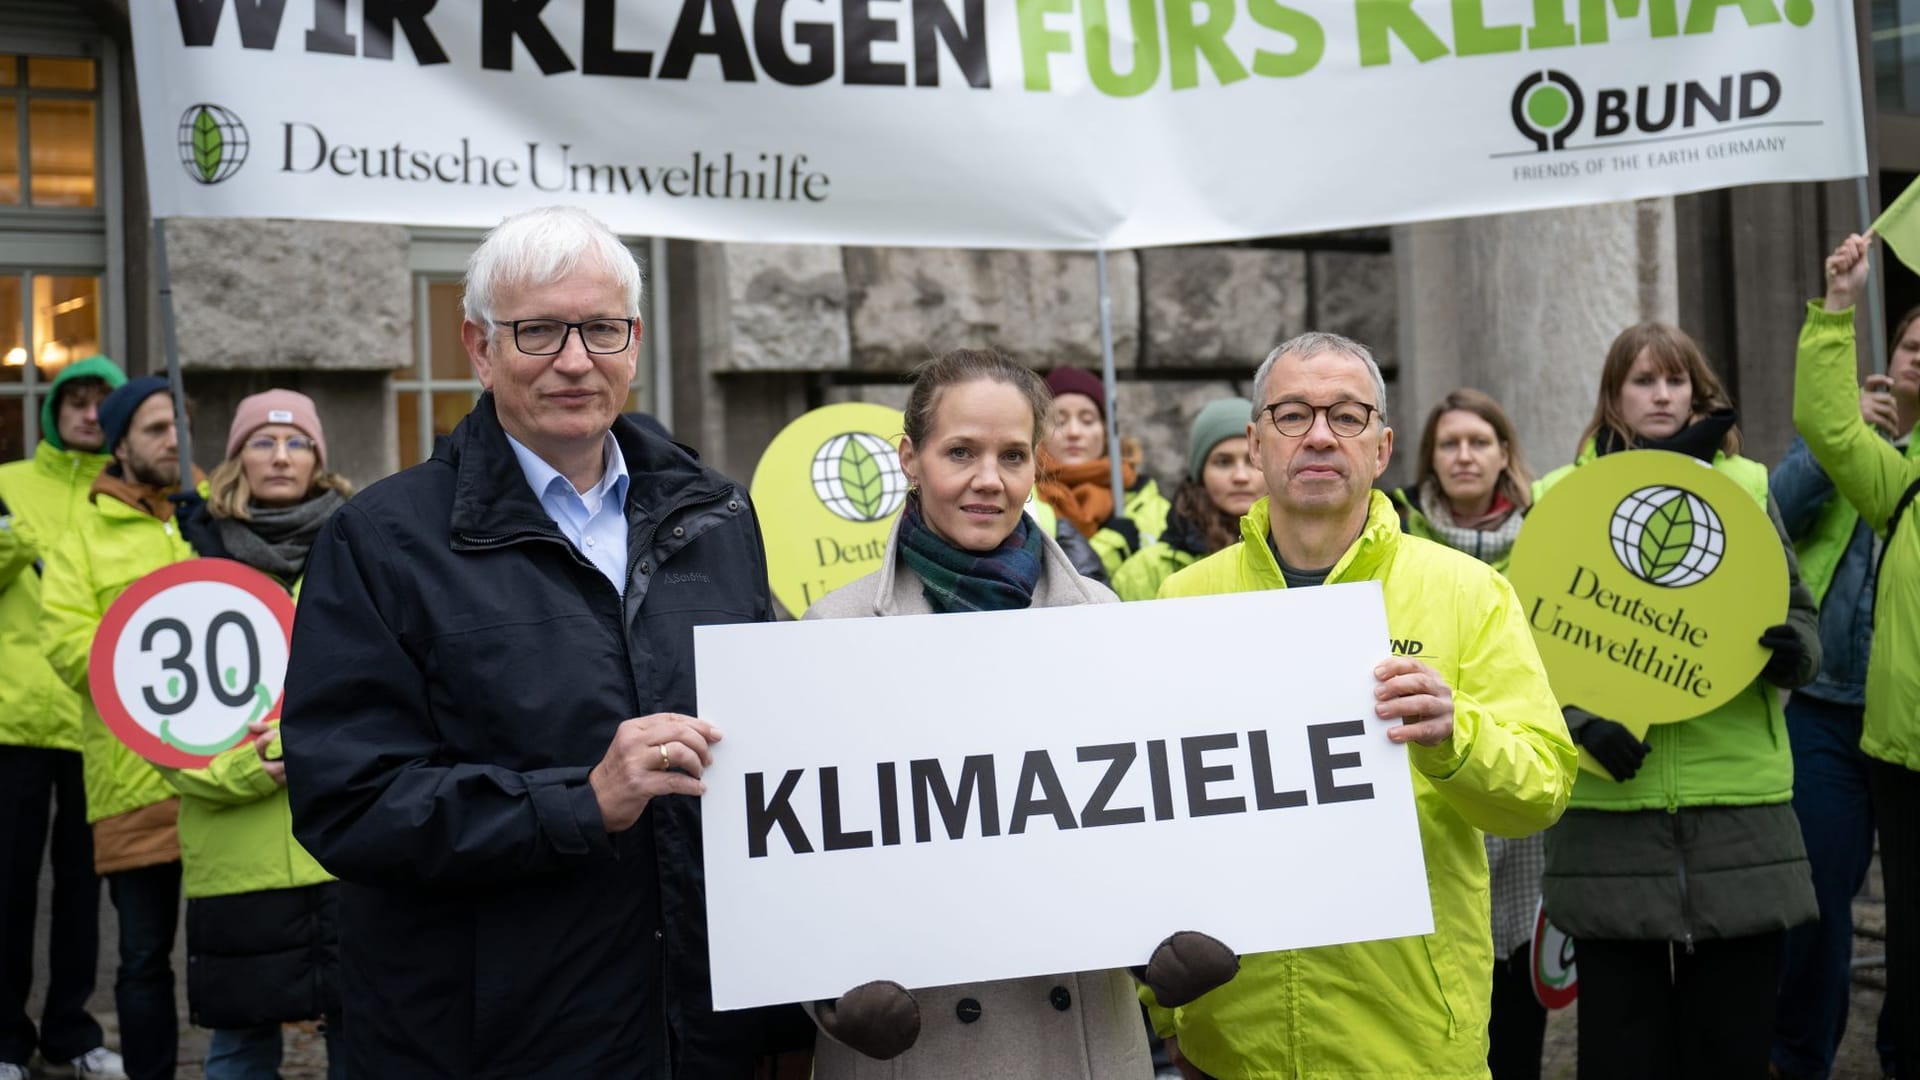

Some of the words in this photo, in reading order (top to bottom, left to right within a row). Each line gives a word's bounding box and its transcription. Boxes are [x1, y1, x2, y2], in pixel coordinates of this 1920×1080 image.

[481, 0, 991, 88] KLAGEN
[1595, 70, 1782, 137] BUND
[281, 121, 519, 187] Deutsche
[526, 142, 831, 202] Umwelthilfe
[1512, 162, 1580, 181] FRIENDS
[1586, 158, 1609, 175] OF
[1613, 155, 1642, 172] THE
[1648, 148, 1701, 168] EARTH
[1706, 136, 1787, 161] GERMANY
[815, 536, 887, 567] Deut
[1389, 638, 1424, 656] ND
[1530, 596, 1712, 698] Umwelthilfe
[1567, 565, 1708, 648] Deutsche
[140, 610, 261, 716] 30
[744, 719, 1375, 859] KLIMAZIELE
